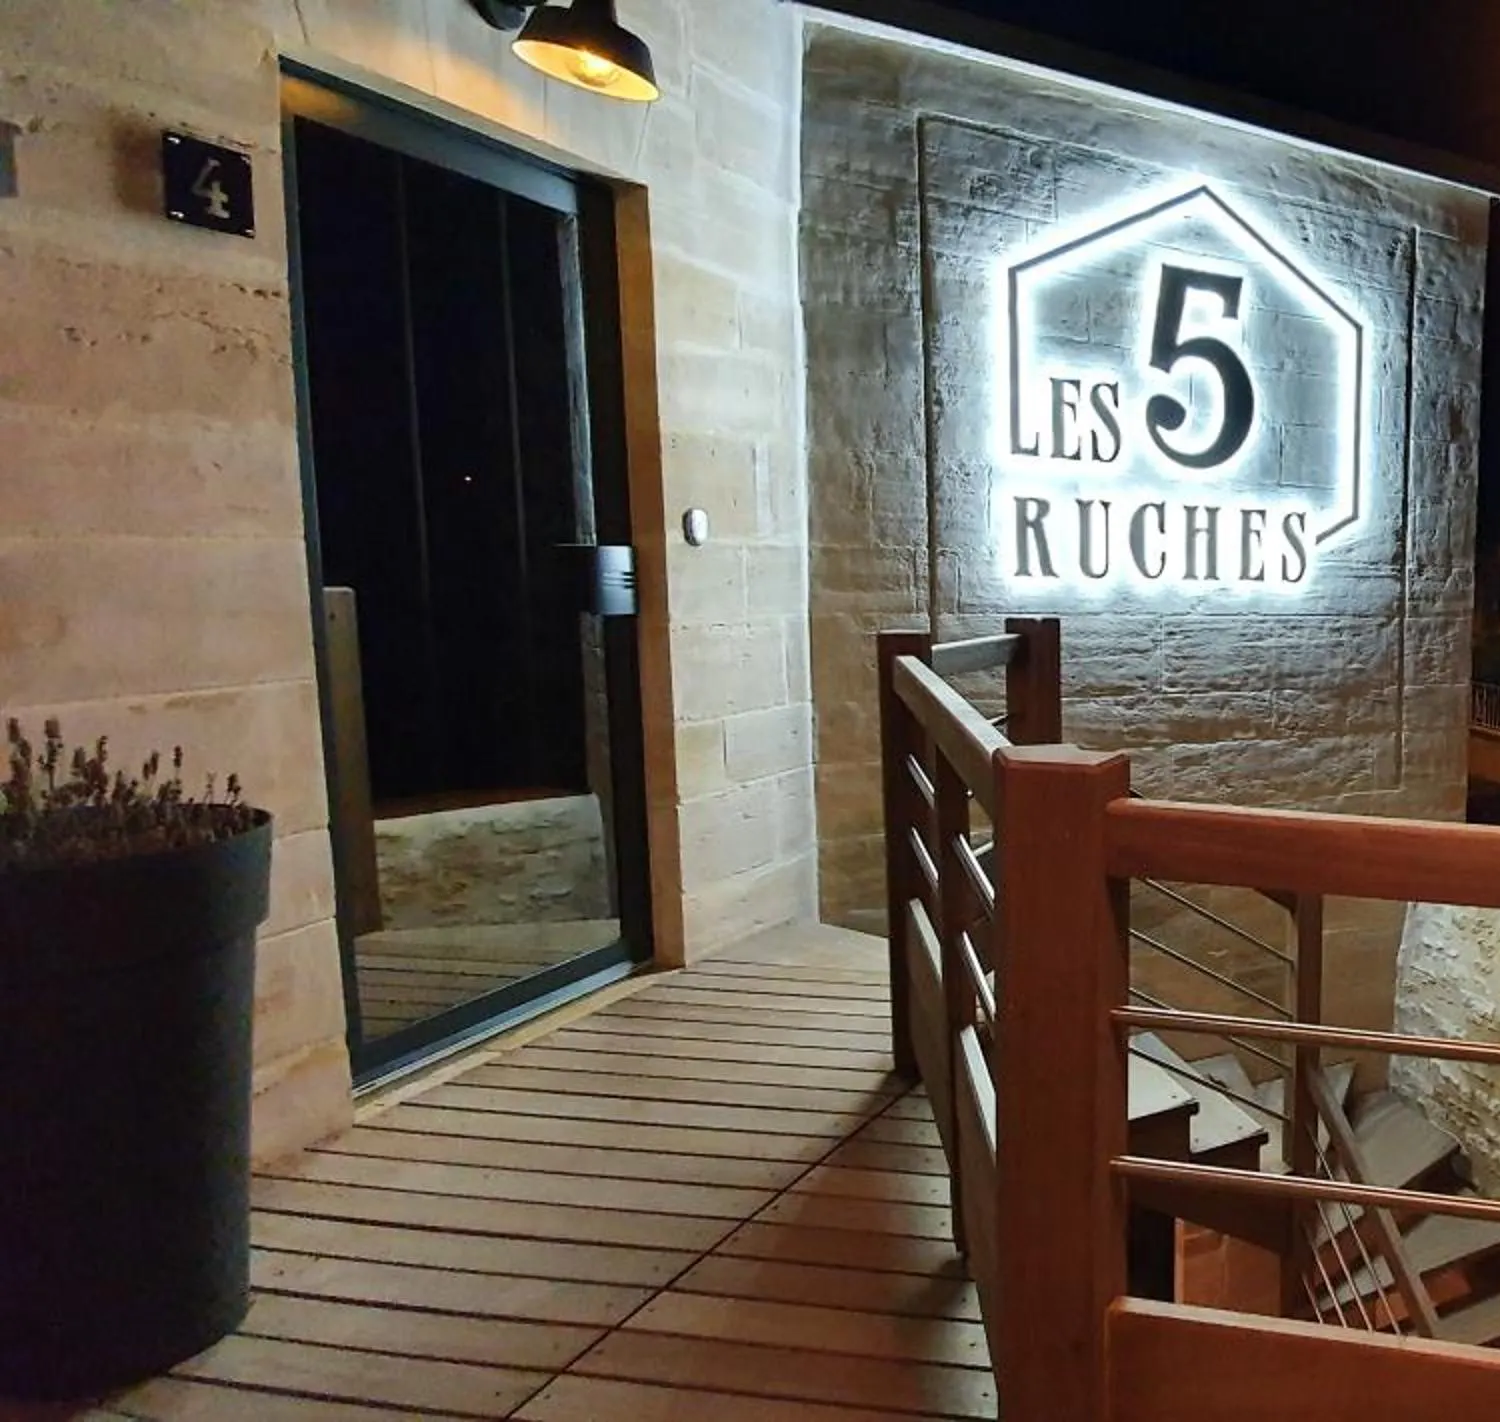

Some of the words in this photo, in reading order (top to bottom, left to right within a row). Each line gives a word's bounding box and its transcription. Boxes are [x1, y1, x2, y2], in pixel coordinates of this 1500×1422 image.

[191, 157, 231, 219] 4
[1009, 376, 1122, 463] LES
[1145, 263, 1255, 469] 5
[1013, 495, 1308, 584] RUCHES
